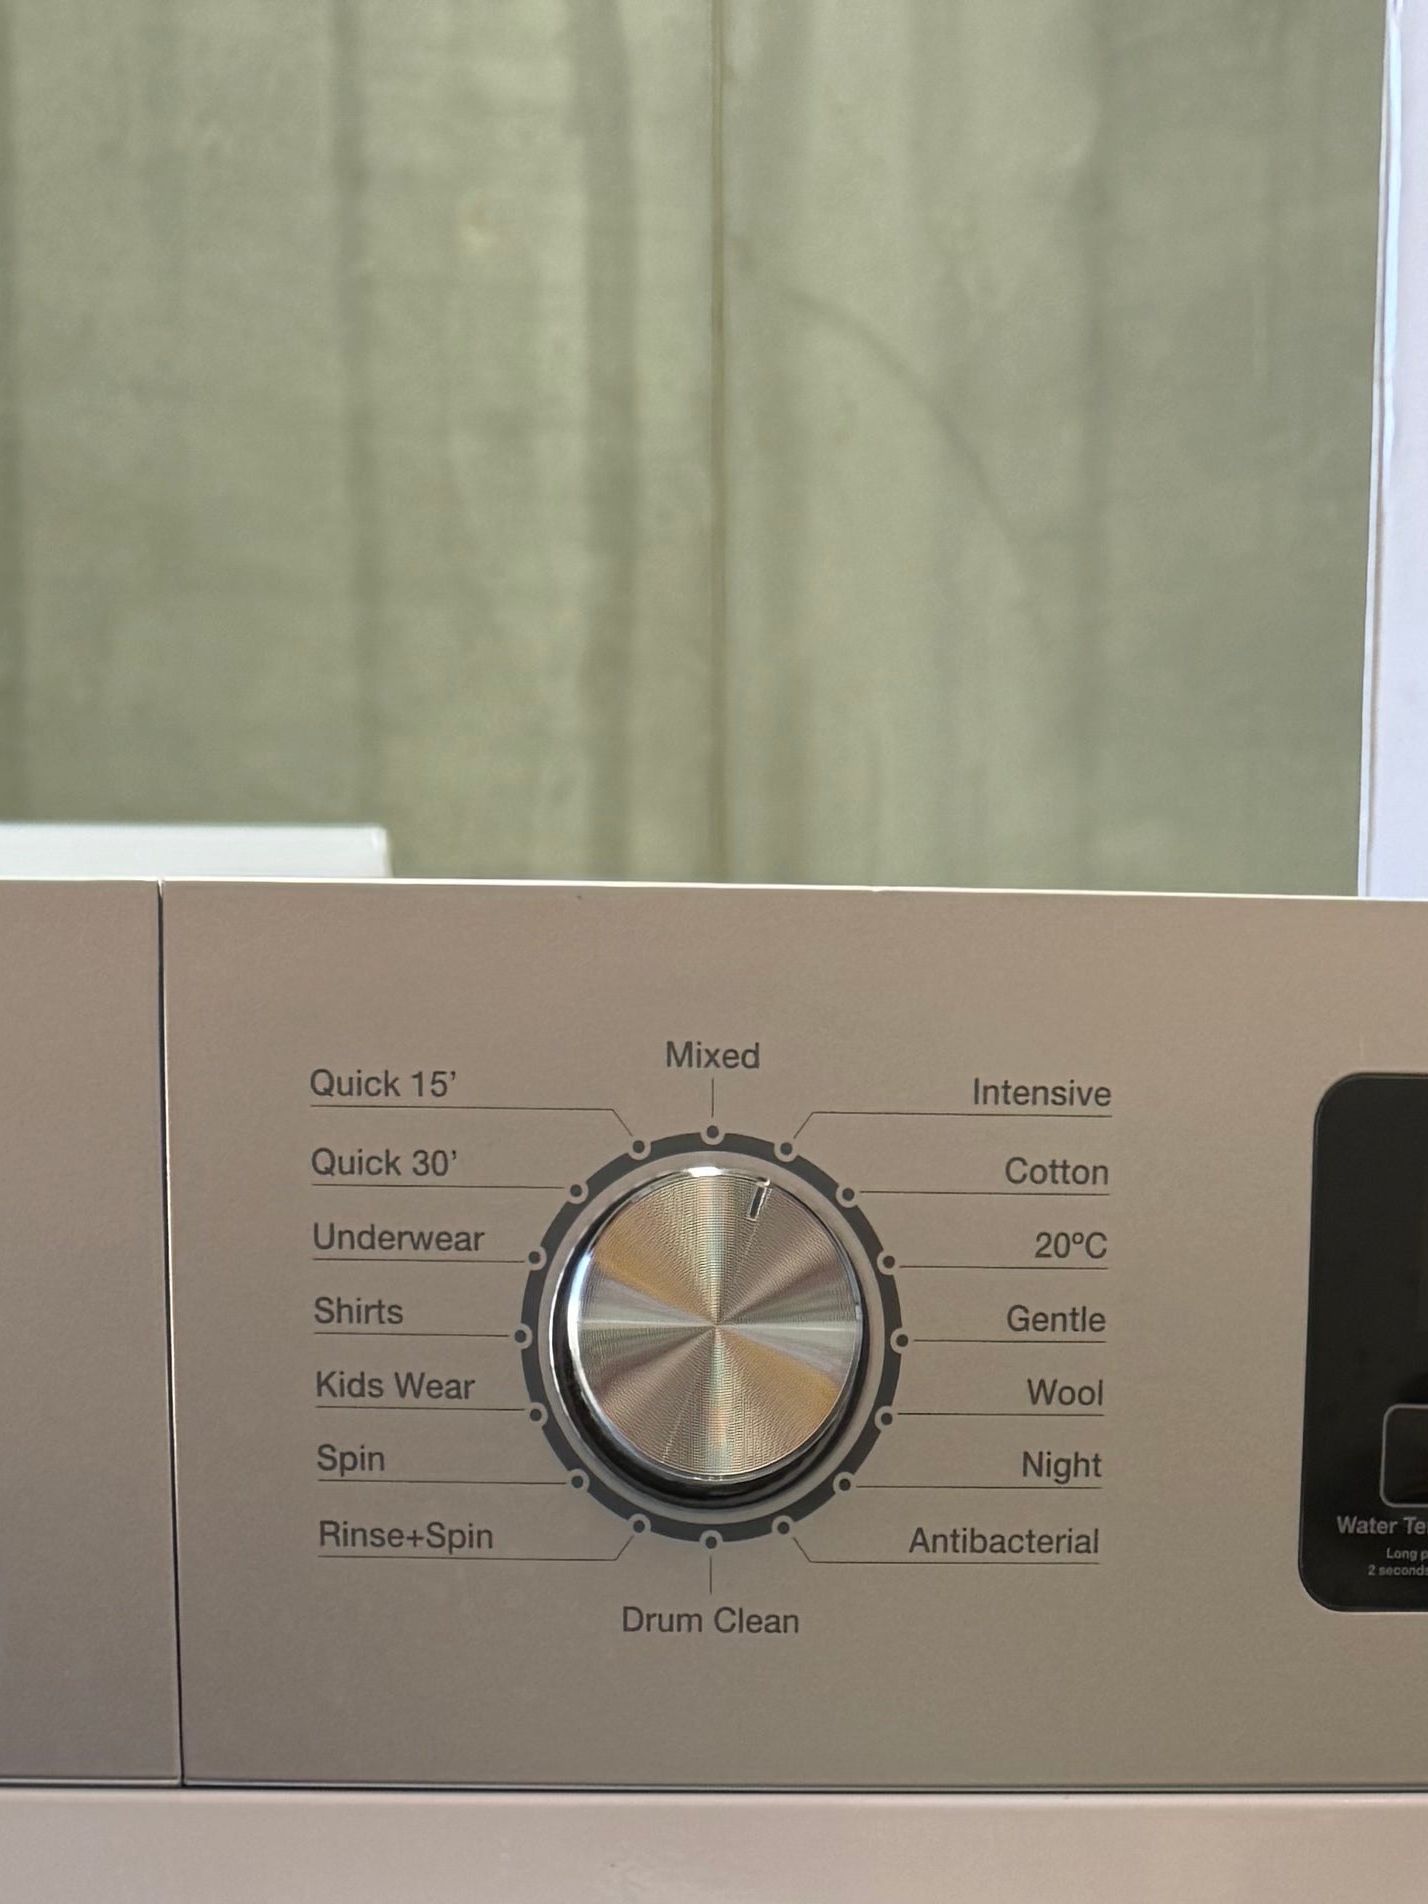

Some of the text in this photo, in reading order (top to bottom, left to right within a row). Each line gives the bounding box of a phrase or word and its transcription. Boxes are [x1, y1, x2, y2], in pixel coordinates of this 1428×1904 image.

[667, 1041, 760, 1069] Mixed
[311, 1069, 400, 1097] Quick
[974, 1078, 1111, 1106] Intensive
[312, 1148, 401, 1176] Quick
[1006, 1157, 1108, 1185] Cotton
[314, 1223, 485, 1251] Underwear
[315, 1297, 403, 1324] Shirts
[1007, 1305, 1106, 1332] Gentle
[317, 1371, 475, 1399] Kids Wear
[1027, 1379, 1103, 1405] Wool
[317, 1444, 384, 1477] Spin
[1023, 1451, 1102, 1484] Night
[320, 1520, 492, 1555] Rinse+Spin
[1337, 1516, 1398, 1534] Water
[909, 1527, 1098, 1554] Antibacterial
[1387, 1548, 1417, 1561] Long
[1368, 1565, 1375, 1575] 2
[623, 1606, 798, 1633] Drum Clean
